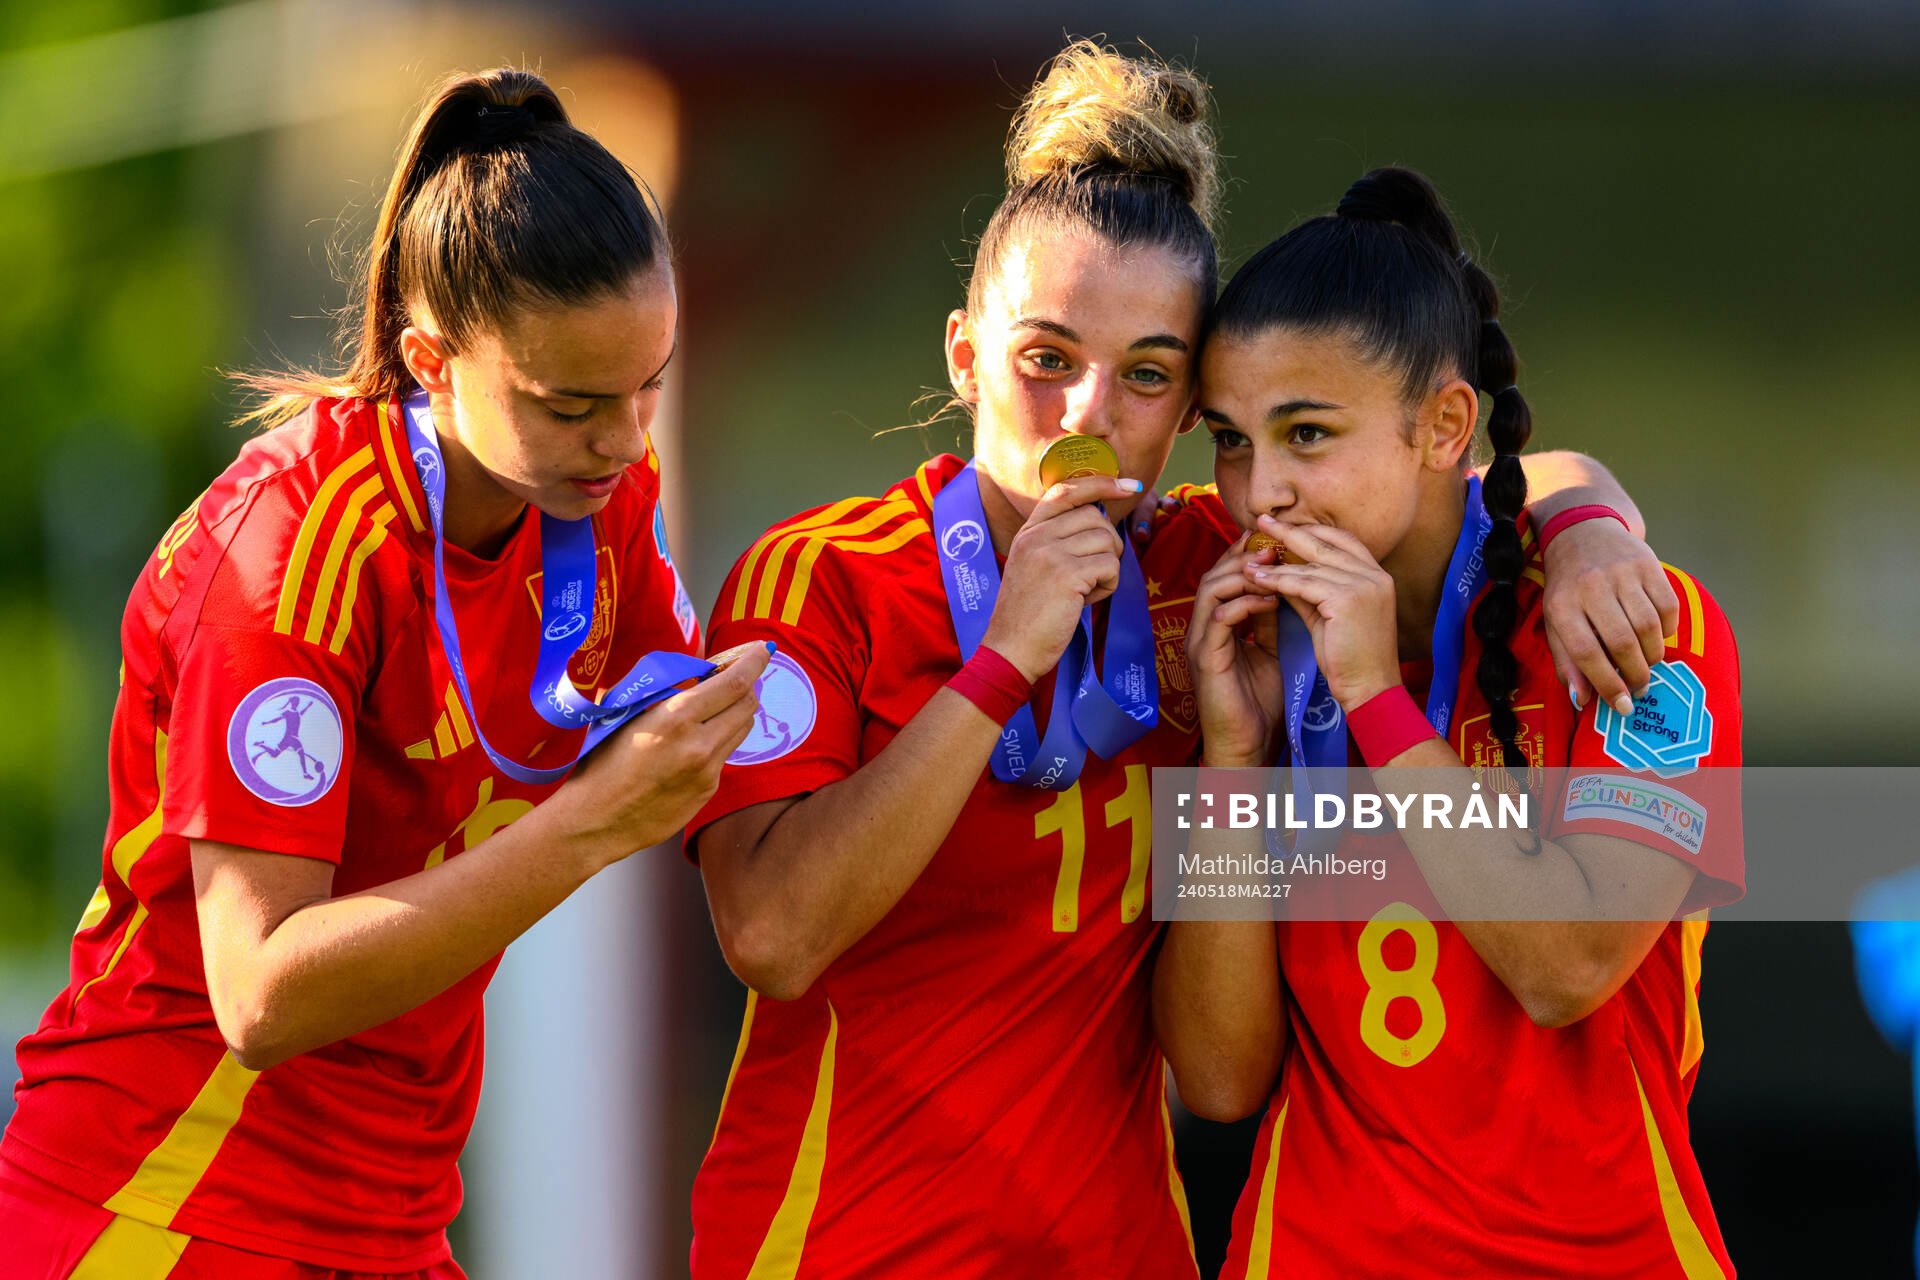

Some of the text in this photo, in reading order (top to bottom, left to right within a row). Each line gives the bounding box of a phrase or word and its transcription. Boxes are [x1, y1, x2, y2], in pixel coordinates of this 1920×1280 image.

[566, 582, 577, 613] UNDER-17
[960, 562, 979, 610] UNDER-17
[1130, 663, 1140, 703] UNDER-17
[1632, 719, 1679, 743] Strong
[1634, 706, 1665, 725] Play
[1033, 756, 1068, 789] 2024
[1571, 776, 1603, 790] UEFA
[1034, 763, 1152, 933] 11
[1663, 822, 1699, 850] for children
[1357, 901, 1447, 1068] 8
